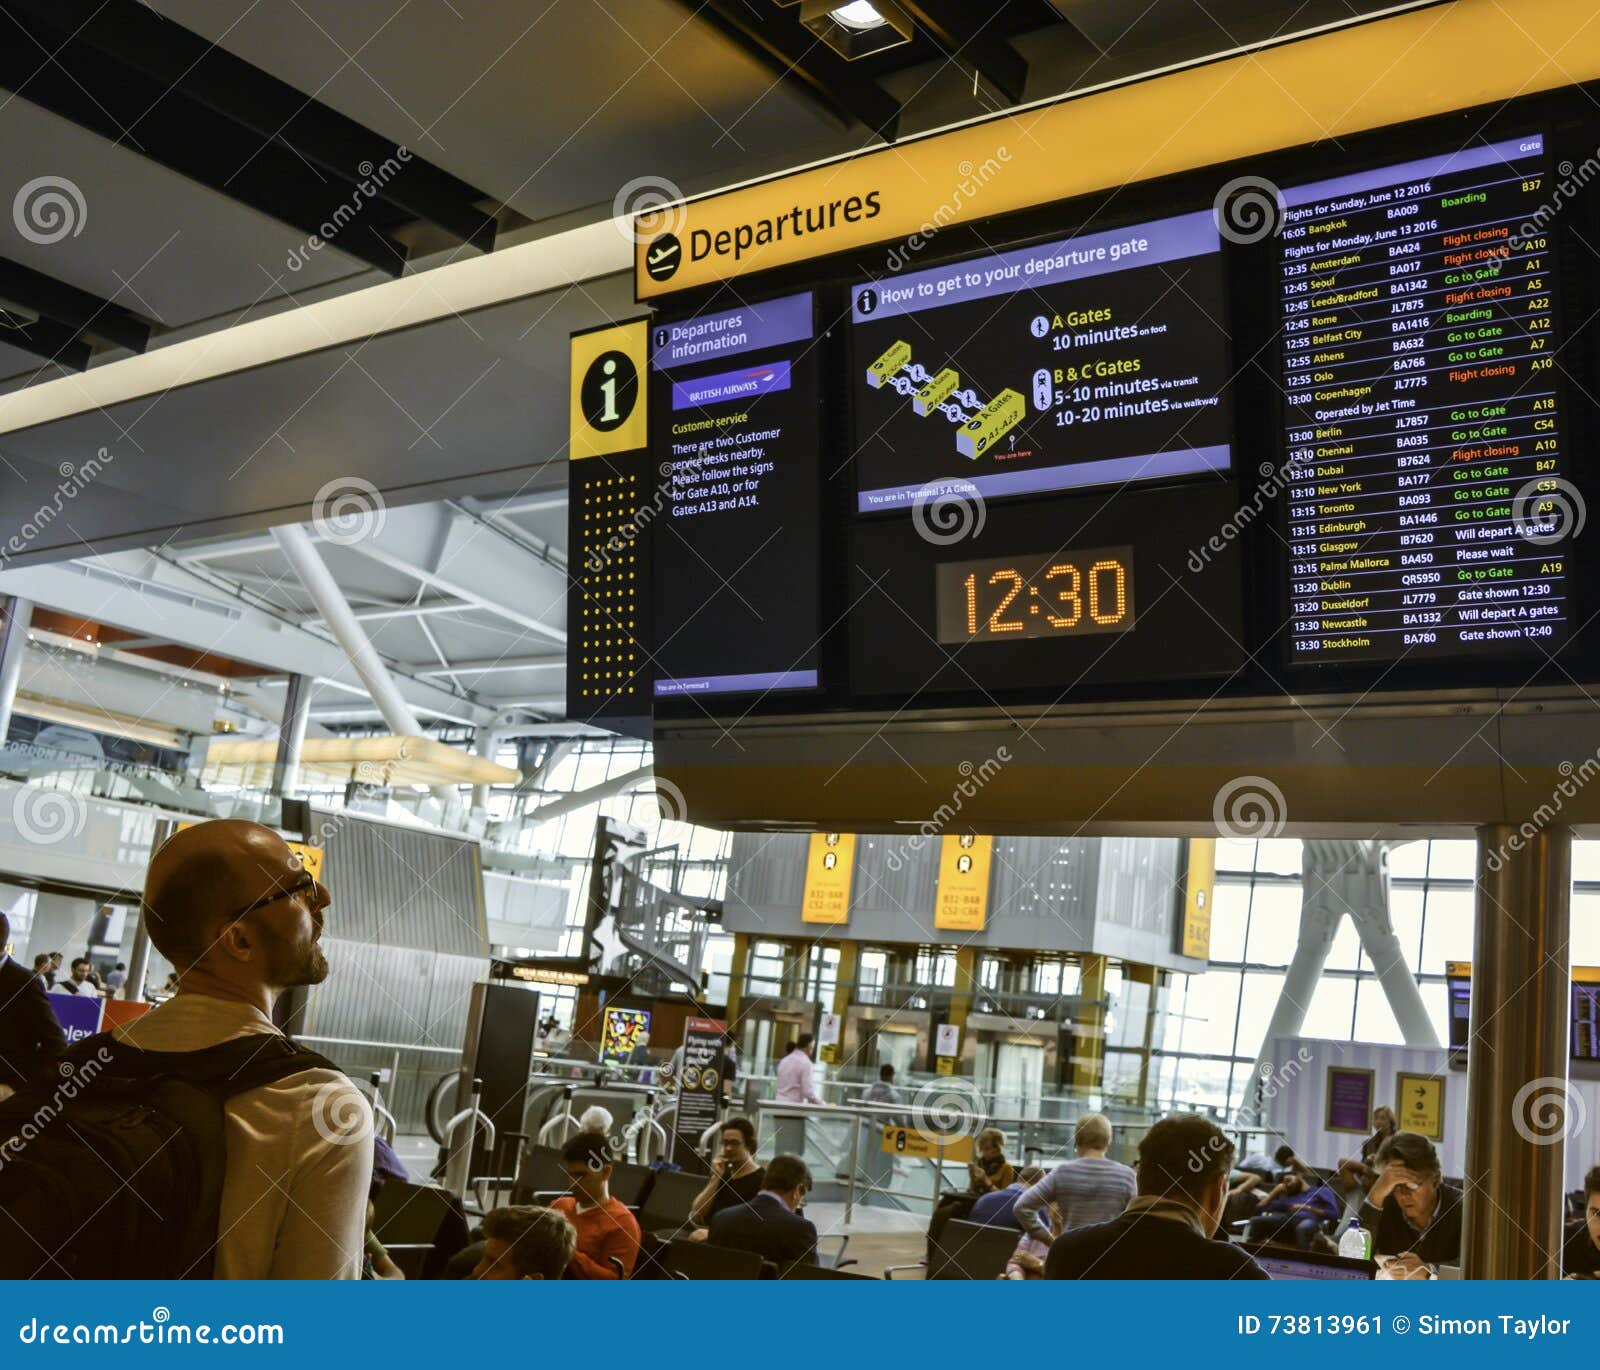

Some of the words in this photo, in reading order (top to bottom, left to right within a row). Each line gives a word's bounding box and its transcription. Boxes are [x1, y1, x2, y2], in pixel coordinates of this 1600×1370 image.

[1520, 141, 1541, 152] Gate
[1282, 227, 1306, 239] 16:05
[1309, 219, 1347, 234] Bangkok
[1387, 204, 1419, 219] BA009
[1442, 193, 1486, 208] Boarding
[1522, 180, 1541, 192] B37
[1283, 209, 1313, 222] Flights
[1315, 206, 1328, 215] for
[1330, 198, 1367, 212] Sunday,
[1369, 193, 1391, 204] June
[1394, 188, 1405, 198] 12
[1407, 182, 1431, 196] 2016
[691, 190, 882, 263] Departures
[1285, 246, 1314, 258] Flights
[1316, 242, 1330, 251] for
[1332, 234, 1373, 248] Monday,
[1375, 230, 1397, 240] June
[1400, 225, 1411, 235] 13
[1413, 220, 1437, 233] 2016
[1284, 264, 1307, 276] 12:35
[1310, 256, 1360, 271] Amsterdam
[1389, 242, 1420, 256] BA424
[1443, 234, 1471, 246] Flight
[1474, 228, 1508, 240] closing
[881, 287, 914, 304] How
[917, 283, 933, 296] to
[937, 276, 961, 296] get
[965, 273, 981, 287] to
[985, 265, 1020, 287] your
[1025, 248, 1106, 274] departure
[1110, 239, 1148, 261] gate
[1285, 319, 1309, 331] 12:45
[1312, 316, 1337, 326] Rome
[1391, 299, 1424, 313] JL7875
[1446, 292, 1474, 304] Flight
[1476, 287, 1511, 298] closing
[1527, 279, 1542, 290] A5
[672, 315, 742, 341] Departures
[1052, 315, 1063, 329] A
[1067, 308, 1111, 326] Gates
[1286, 337, 1310, 349] 12:55
[1313, 333, 1342, 344] Belfast
[1345, 330, 1362, 340] City
[1392, 317, 1429, 332] BA1416
[1446, 309, 1492, 323] Boarding
[1528, 298, 1548, 310] A22
[672, 333, 747, 358] information
[1053, 334, 1070, 350] 10
[1074, 325, 1138, 347] minutes
[1148, 325, 1167, 334] foot
[1054, 369, 1063, 383] B
[1067, 367, 1078, 381] &
[1081, 364, 1092, 379] C
[1096, 359, 1140, 376] Gates
[1288, 393, 1312, 404] 13:00
[1315, 387, 1371, 401] Copenhagen
[1394, 376, 1427, 390] JL7775
[1449, 370, 1477, 382] Flight
[1480, 366, 1515, 377] closing
[1531, 358, 1552, 370] A10
[690, 387, 722, 402] BRITISH
[723, 380, 758, 395] AIRWAYS
[1055, 386, 1090, 405] 5-10
[1094, 378, 1159, 399] minutes
[1160, 381, 1172, 389] via
[1173, 376, 1198, 387] transit
[988, 393, 1012, 414] Gates
[1056, 406, 1100, 426] 10-20
[1104, 399, 1169, 419] minutes
[1183, 398, 1218, 408] walkway
[1315, 405, 1360, 421] Operated
[1362, 404, 1373, 415] by
[1375, 402, 1390, 412] Jet
[1391, 399, 1416, 409] Time
[672, 419, 714, 434] Customer
[716, 413, 748, 427] service
[988, 410, 1019, 441] A1-A23
[672, 443, 698, 454] There
[699, 440, 714, 451] are
[716, 437, 734, 448] two
[735, 429, 780, 444] Customer
[672, 457, 702, 470] service
[703, 452, 728, 465] desks
[730, 447, 765, 460] nearby.
[1290, 469, 1314, 480] 13:10
[1317, 465, 1344, 476] Dubai
[1397, 454, 1430, 467] IB7624
[1452, 449, 1481, 461] Flight
[1484, 446, 1519, 456] closing
[1536, 440, 1556, 451] A10
[672, 474, 700, 485] Please
[702, 469, 731, 481] follow
[732, 465, 748, 476] the
[750, 462, 774, 475] signs
[672, 490, 686, 501] for
[687, 488, 709, 499] Gate
[710, 483, 730, 495] A10,
[732, 483, 743, 492] or
[745, 479, 759, 490] for
[868, 494, 882, 504] You
[883, 494, 896, 502] are
[898, 492, 905, 500] in
[906, 487, 939, 499] Terminal
[954, 483, 976, 493] Gates
[672, 505, 698, 516] Gates
[699, 500, 717, 512] A13
[719, 497, 736, 510] and
[738, 495, 759, 507] A14.
[1293, 563, 1317, 574] 13:15
[1320, 562, 1347, 571] Palma
[1350, 558, 1389, 568] Mallorca
[1401, 553, 1433, 565] BA450
[1456, 549, 1488, 560] Please
[1490, 546, 1514, 557] wait
[964, 560, 1126, 634] 12:30
[1296, 640, 1320, 650] 13:30
[1322, 638, 1370, 648] Stockholm
[1404, 633, 1436, 644] BA780
[1459, 631, 1484, 640] Gate
[1486, 629, 1521, 639] shown
[1524, 626, 1552, 637] 12:40
